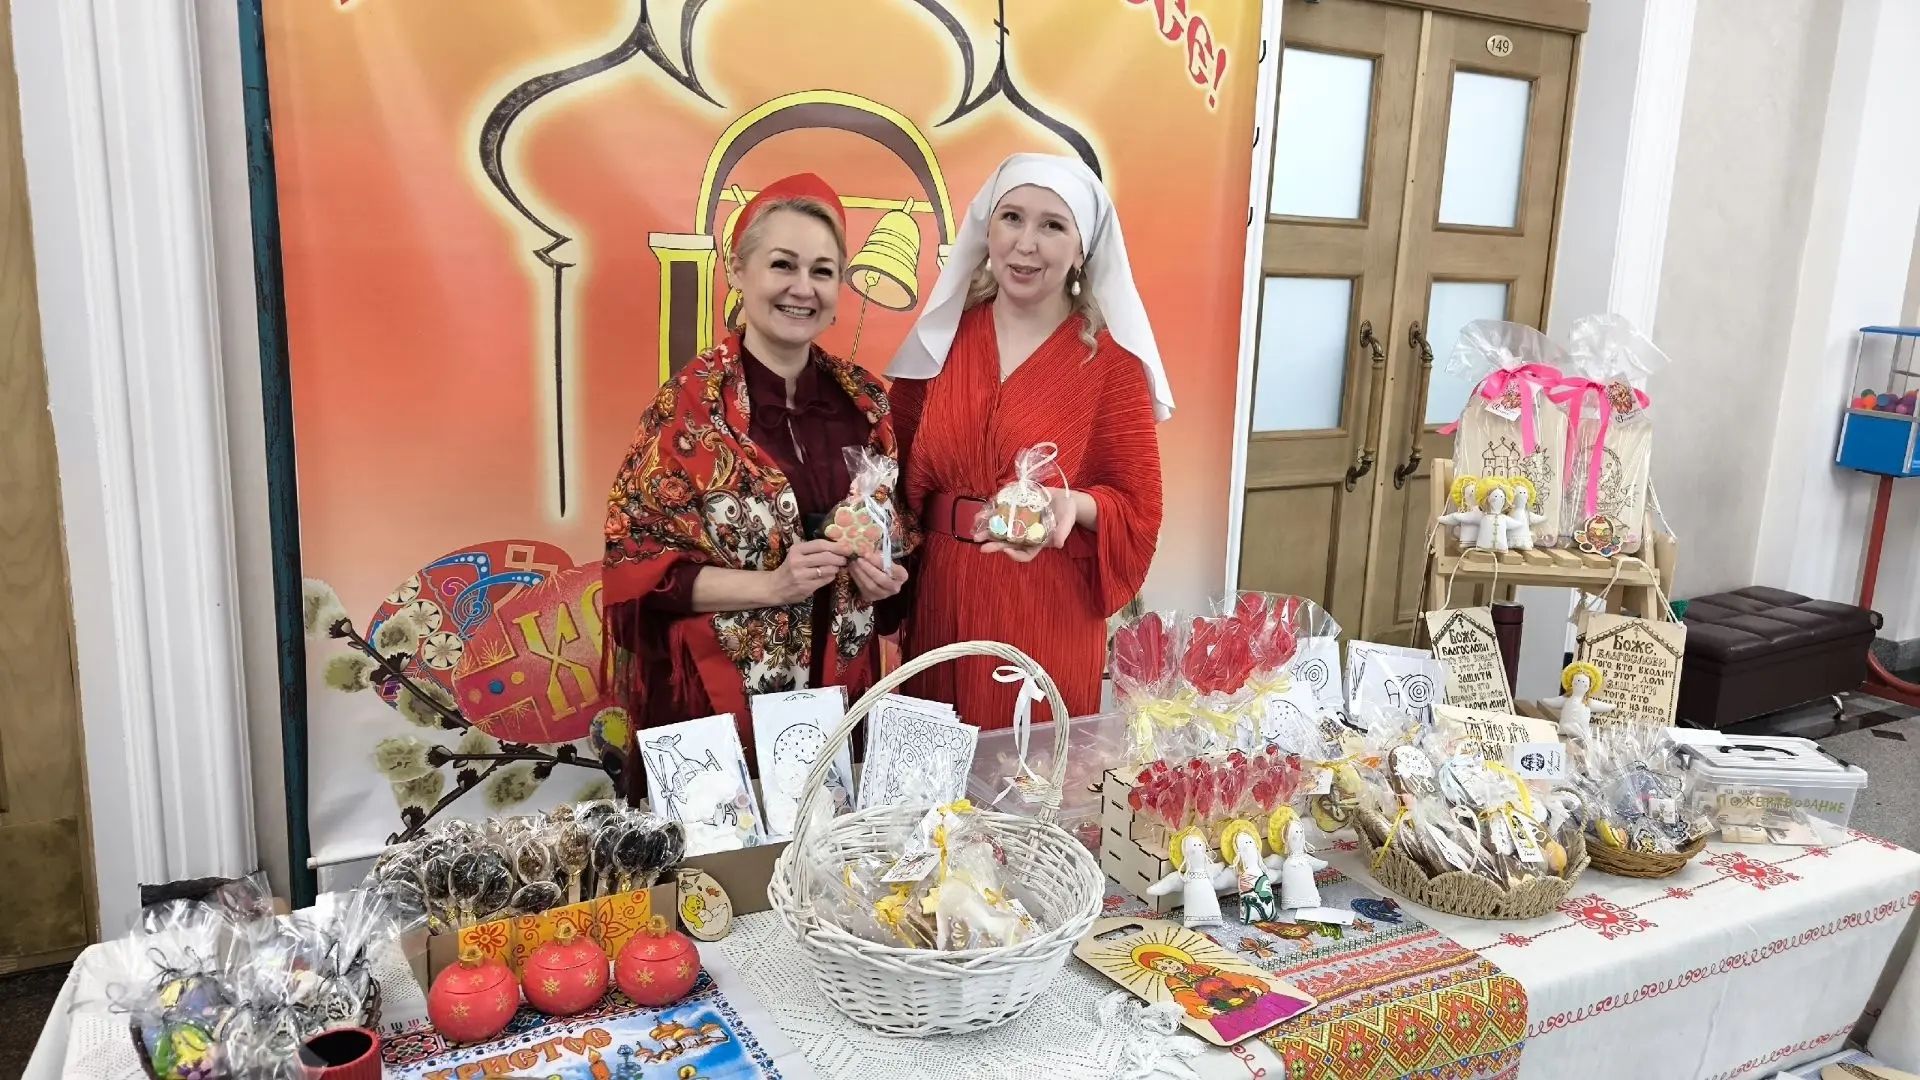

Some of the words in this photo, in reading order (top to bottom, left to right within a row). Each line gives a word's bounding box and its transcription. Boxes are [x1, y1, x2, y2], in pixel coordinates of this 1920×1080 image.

[1491, 38, 1510, 54] 149
[1616, 662, 1633, 672] КТО
[1639, 666, 1674, 678] ВХОДИТ
[1613, 671, 1636, 681] ЭТОТ
[1640, 676, 1664, 686] ДОМ
[1630, 694, 1649, 704] КТО
